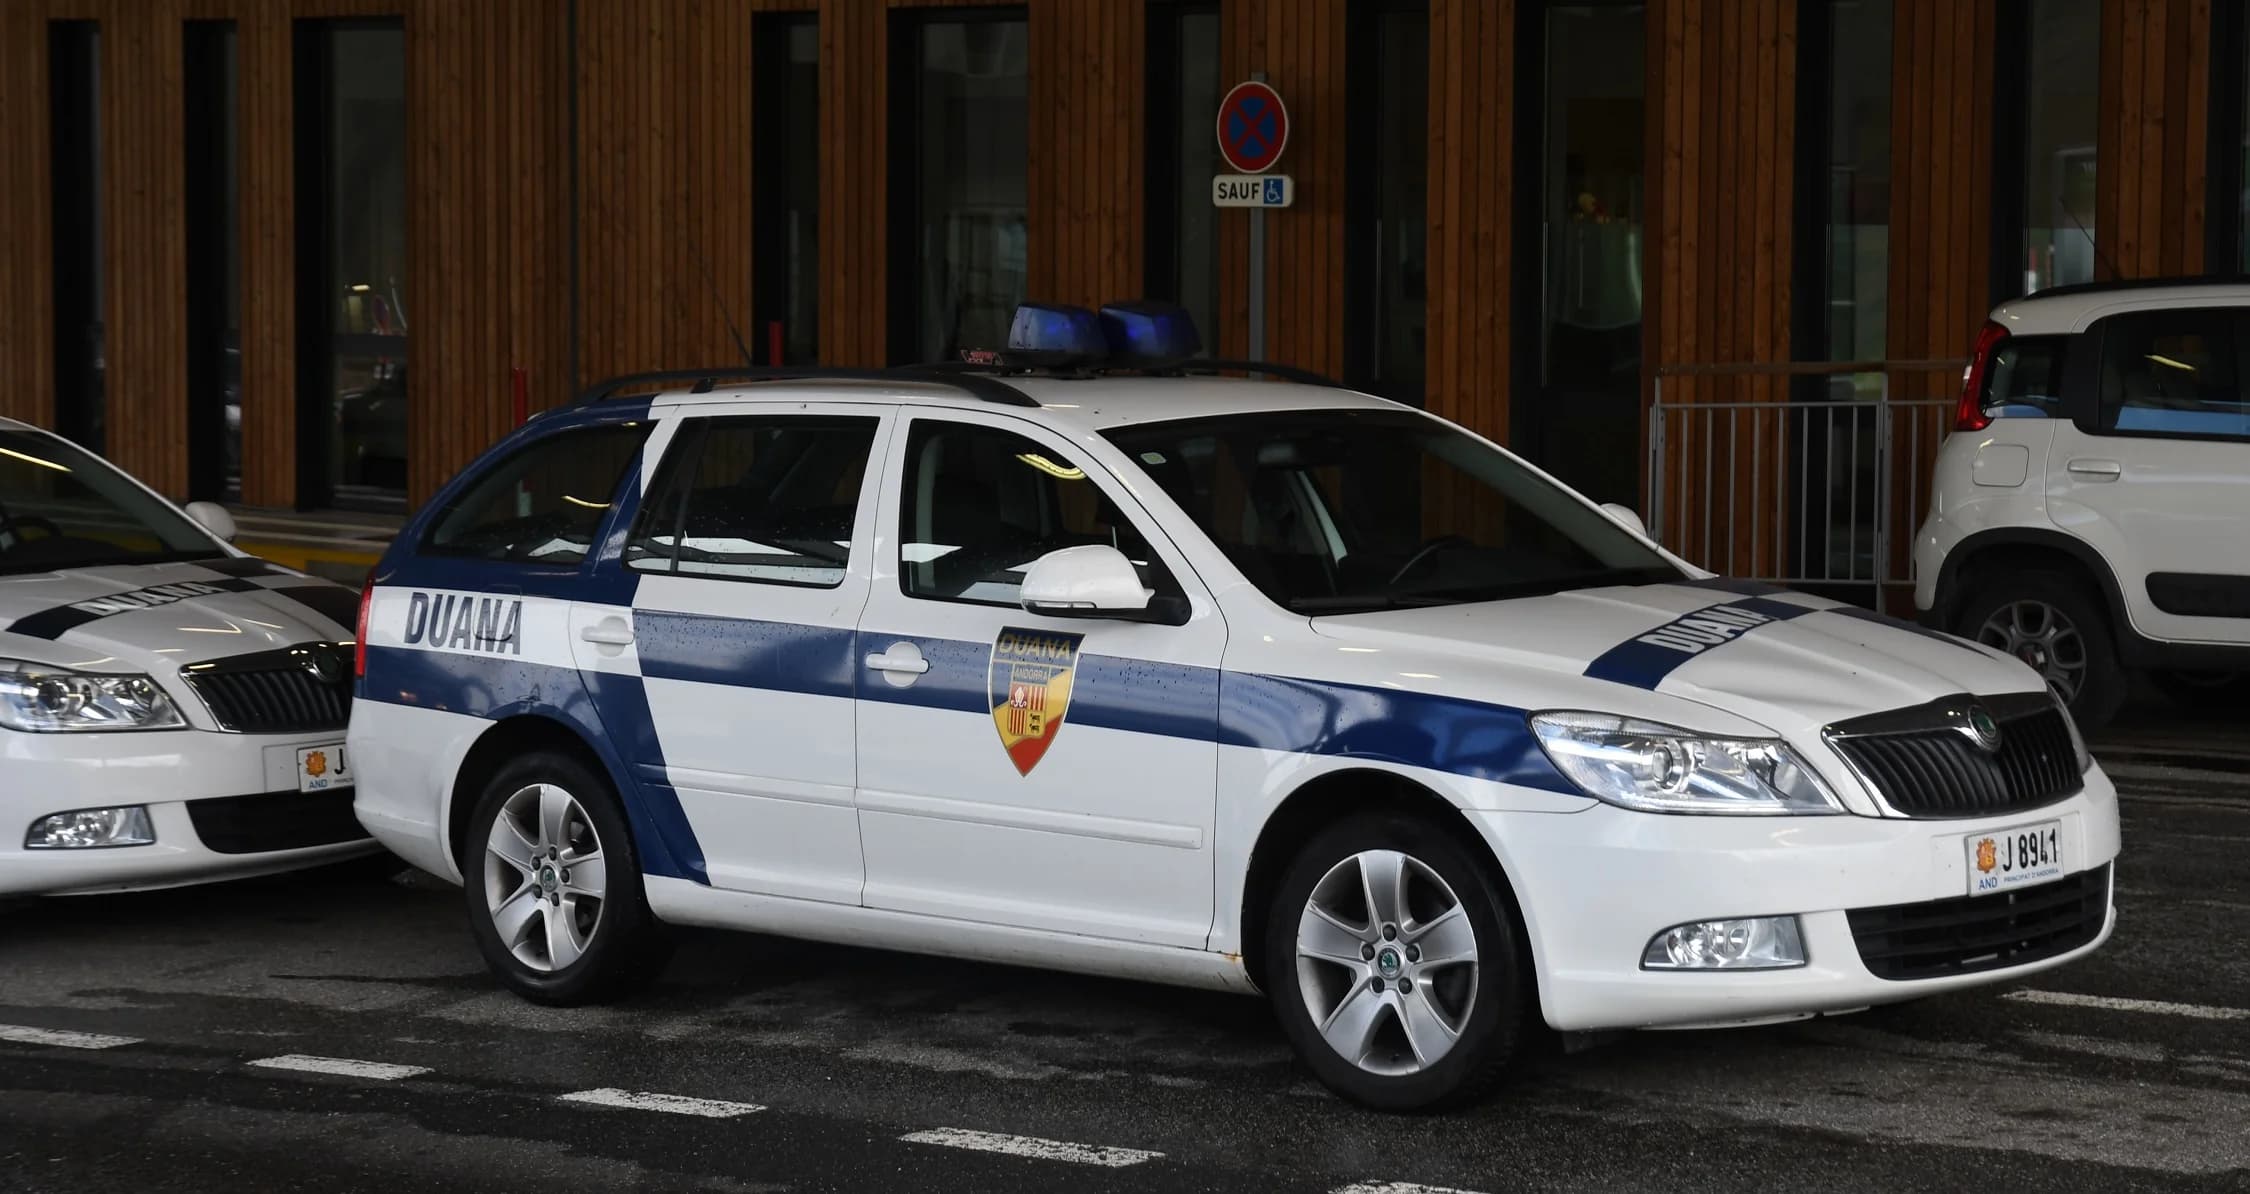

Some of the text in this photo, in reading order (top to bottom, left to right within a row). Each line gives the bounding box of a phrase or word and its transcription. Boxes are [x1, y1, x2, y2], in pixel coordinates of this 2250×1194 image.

[1218, 182, 1260, 200] SAUF
[69, 580, 230, 616] DUANA
[404, 591, 523, 655] DUANA
[1636, 604, 1772, 654] DUANA
[998, 633, 1072, 660] DUANA
[1014, 667, 1049, 682] ANDORRA
[334, 748, 344, 775] J
[308, 778, 328, 789] AND
[2002, 828, 2058, 872] J 8941
[1978, 877, 1998, 890] AND
